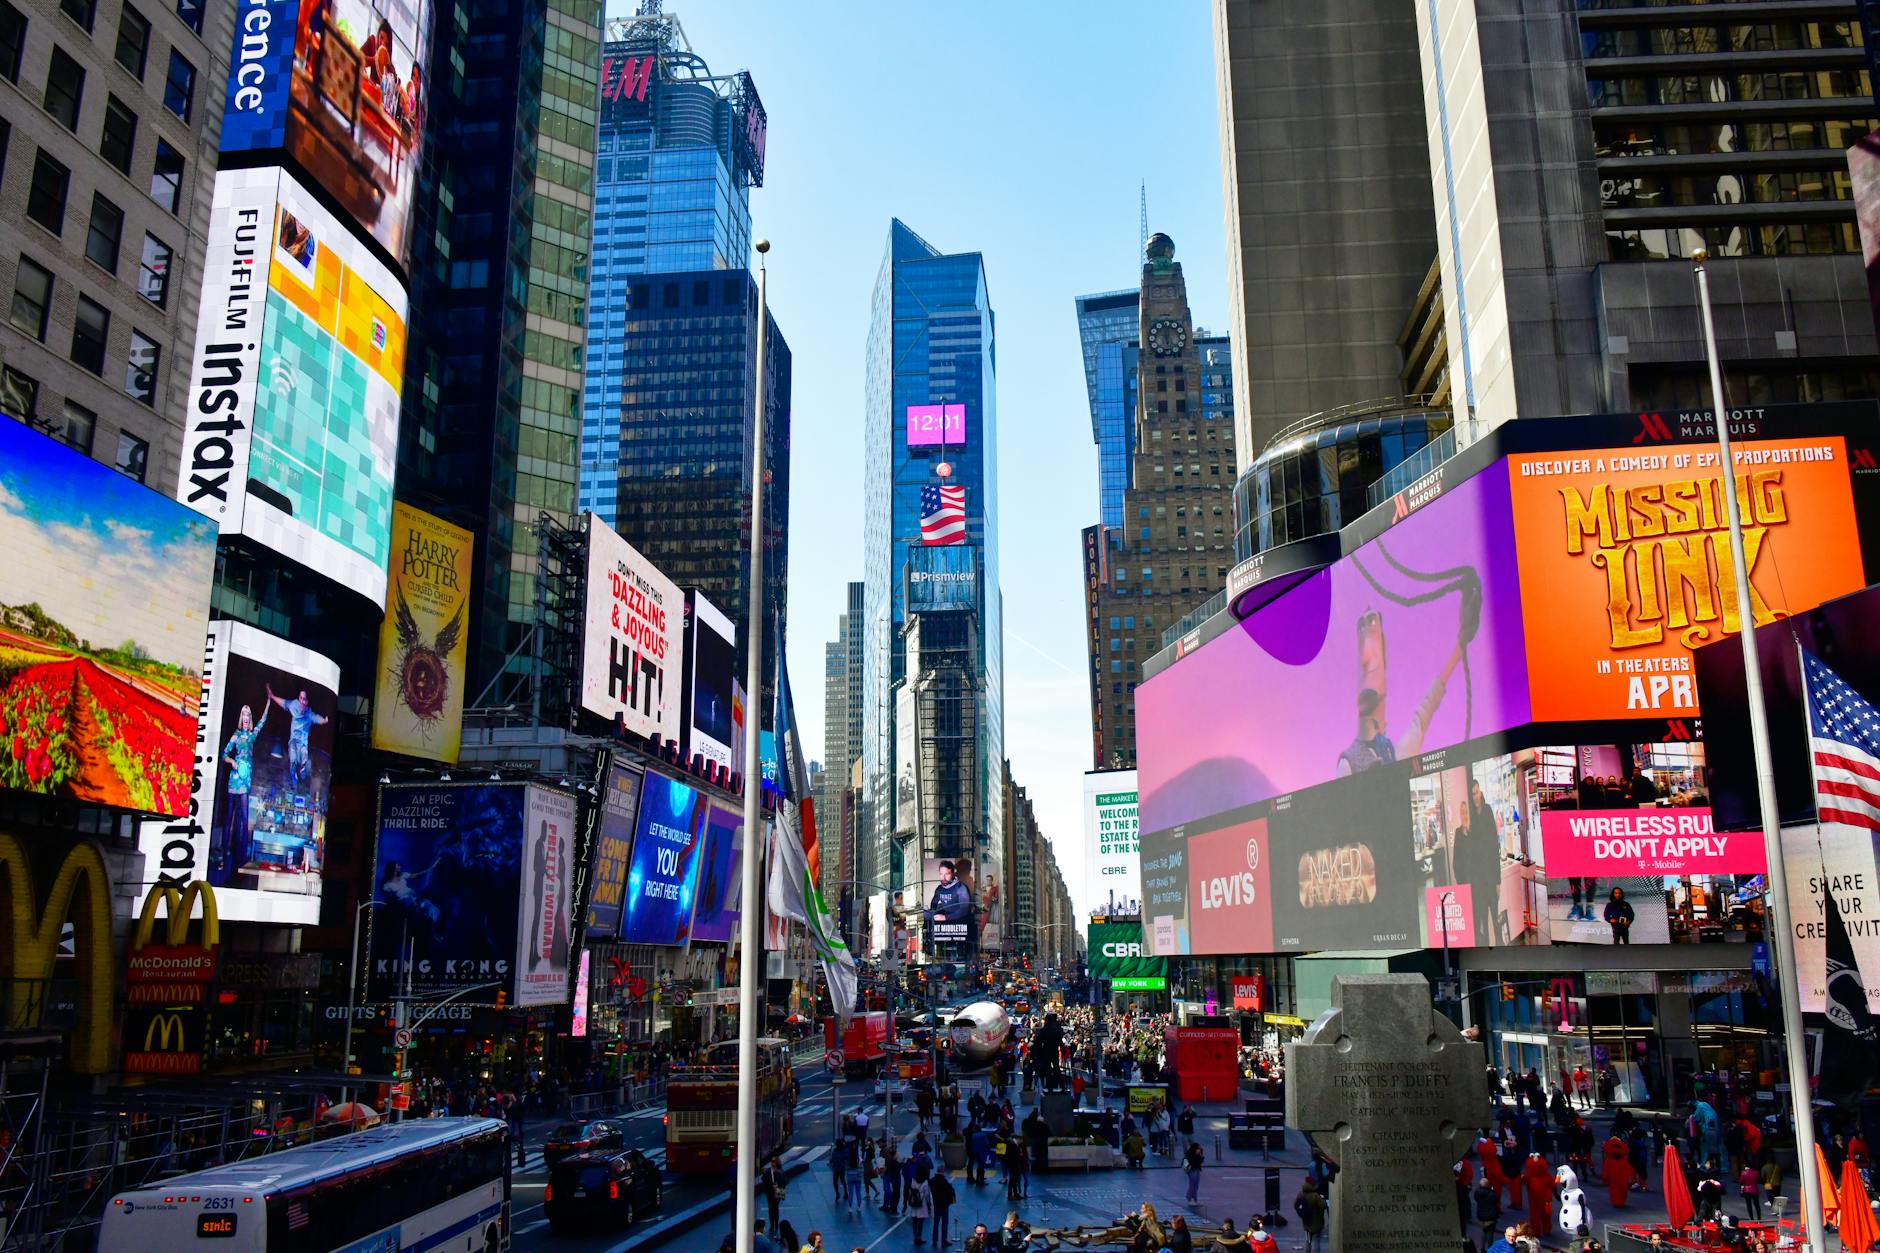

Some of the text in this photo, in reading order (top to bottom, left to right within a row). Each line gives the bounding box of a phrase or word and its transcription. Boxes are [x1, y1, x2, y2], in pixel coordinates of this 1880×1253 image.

[188, 343, 255, 503] instax
[911, 414, 961, 431] 12:01
[1679, 409, 1766, 424] MARIOTT
[1681, 423, 1757, 437] MARUIS
[1521, 446, 1834, 477] DISCOVER A COMEDY OF EPI PROPORTIONS
[1409, 468, 1444, 497] MARRIOTT
[1410, 484, 1442, 510] MARQUIS
[408, 528, 459, 570] HARRY
[402, 549, 460, 592] POTTER
[921, 571, 975, 582] Prismview
[617, 560, 663, 605] DON'T MISS THIS
[1591, 527, 1793, 651] LINK
[407, 581, 433, 598] CURSED
[433, 588, 454, 604] CHILD
[611, 604, 620, 630] &
[1597, 658, 1690, 674] IN THEATERS
[608, 635, 664, 723] HIT!
[1422, 750, 1446, 764] MARRIOTT
[429, 794, 455, 805] EPIC.
[1111, 794, 1135, 803] MARKET
[391, 806, 441, 817] DAZZLING
[384, 818, 418, 829] THRILL
[1100, 820, 1130, 831] TO THE
[1569, 815, 1678, 838] WIRELESS
[649, 822, 692, 846] LET THE WORLD SEE
[1101, 832, 1129, 842] ESTATE
[602, 836, 629, 862] COME
[1101, 843, 1130, 854] OF THE
[1594, 837, 1728, 859] DON'T APPLY
[656, 846, 679, 877] YOU
[1309, 849, 1361, 882] NAKED
[1102, 866, 1127, 874] CBRE
[645, 880, 680, 900] RIGHT HERE
[1809, 874, 1864, 893] SHARE
[1816, 897, 1862, 915] YUR
[130, 957, 212, 968] McDonald's
[378, 960, 509, 973] KING KONG
[143, 970, 196, 978] Restaurant
[1129, 980, 1148, 988] YORK
[1334, 1074, 1450, 1088] FRANCIS DUFFY
[1405, 1183, 1444, 1192] SERVICE
[204, 1197, 235, 1209] 2631
[1402, 1204, 1447, 1213] COUNTRY
